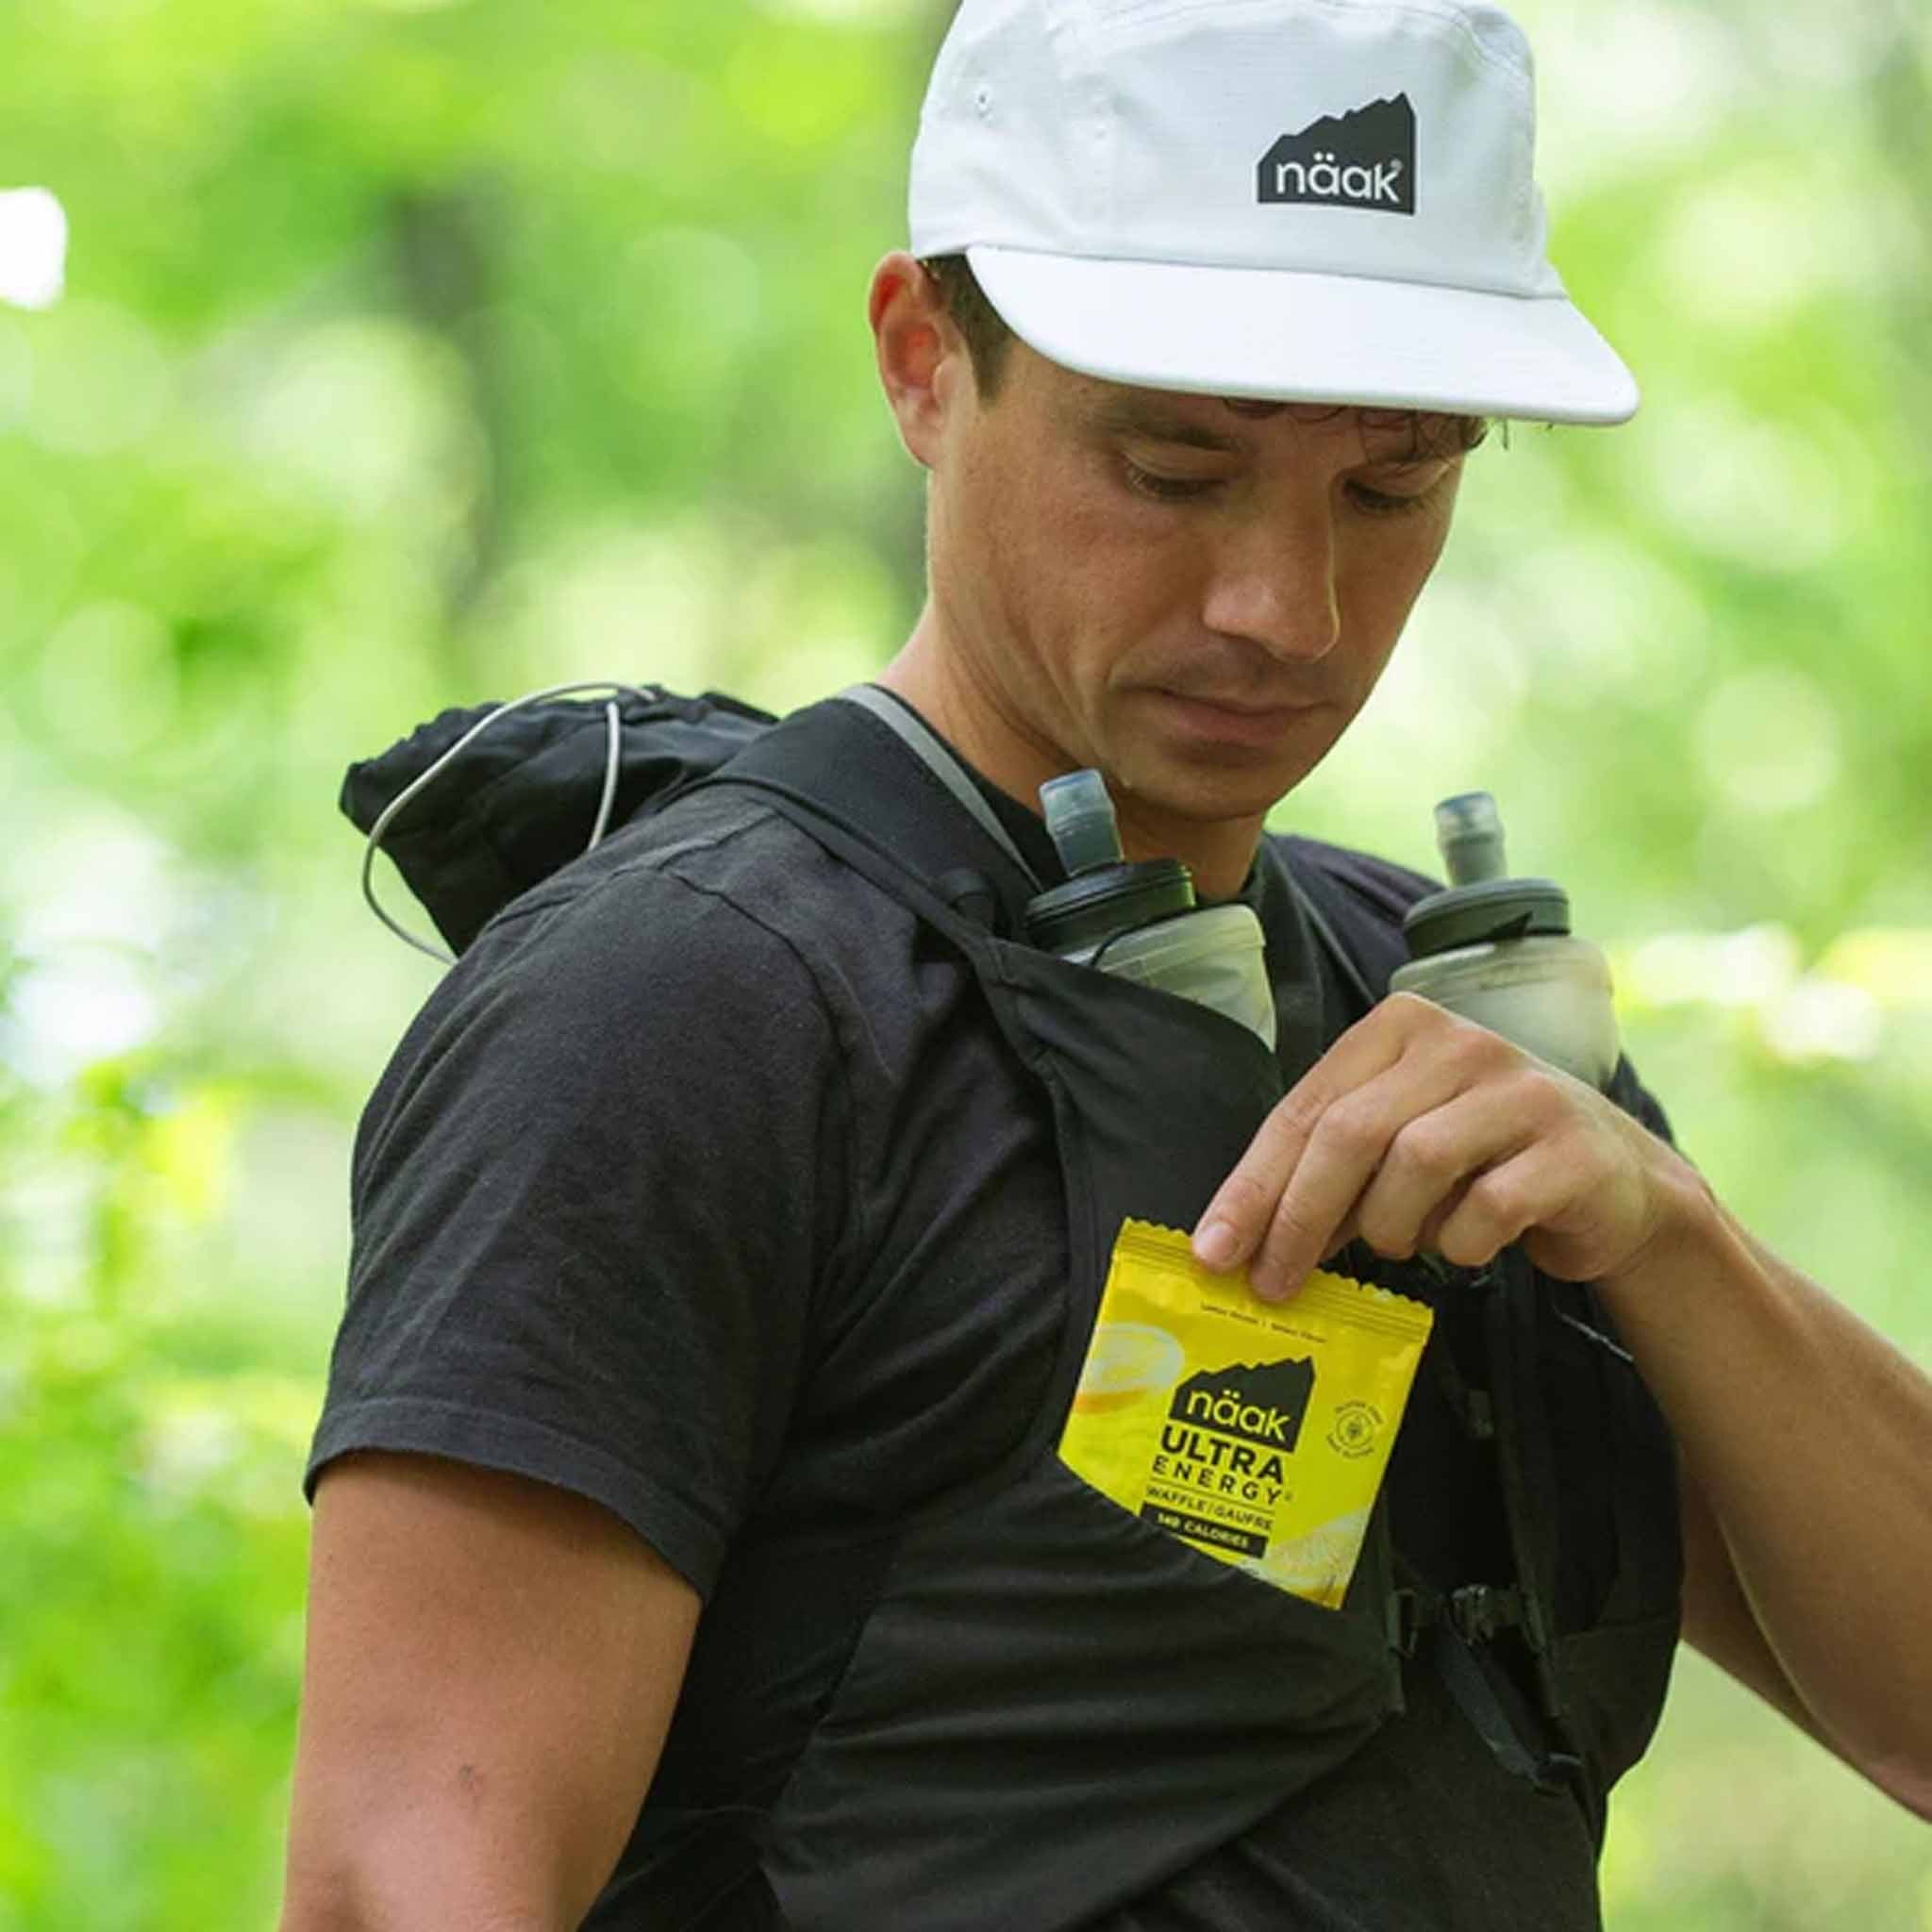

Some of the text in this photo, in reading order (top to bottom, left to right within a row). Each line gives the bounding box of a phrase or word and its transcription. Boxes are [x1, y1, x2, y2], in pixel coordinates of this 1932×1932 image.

[1187, 1390, 1291, 1442] näak
[1152, 1455, 1282, 1505] ENERGY
[1161, 1424, 1283, 1485] ULTRA
